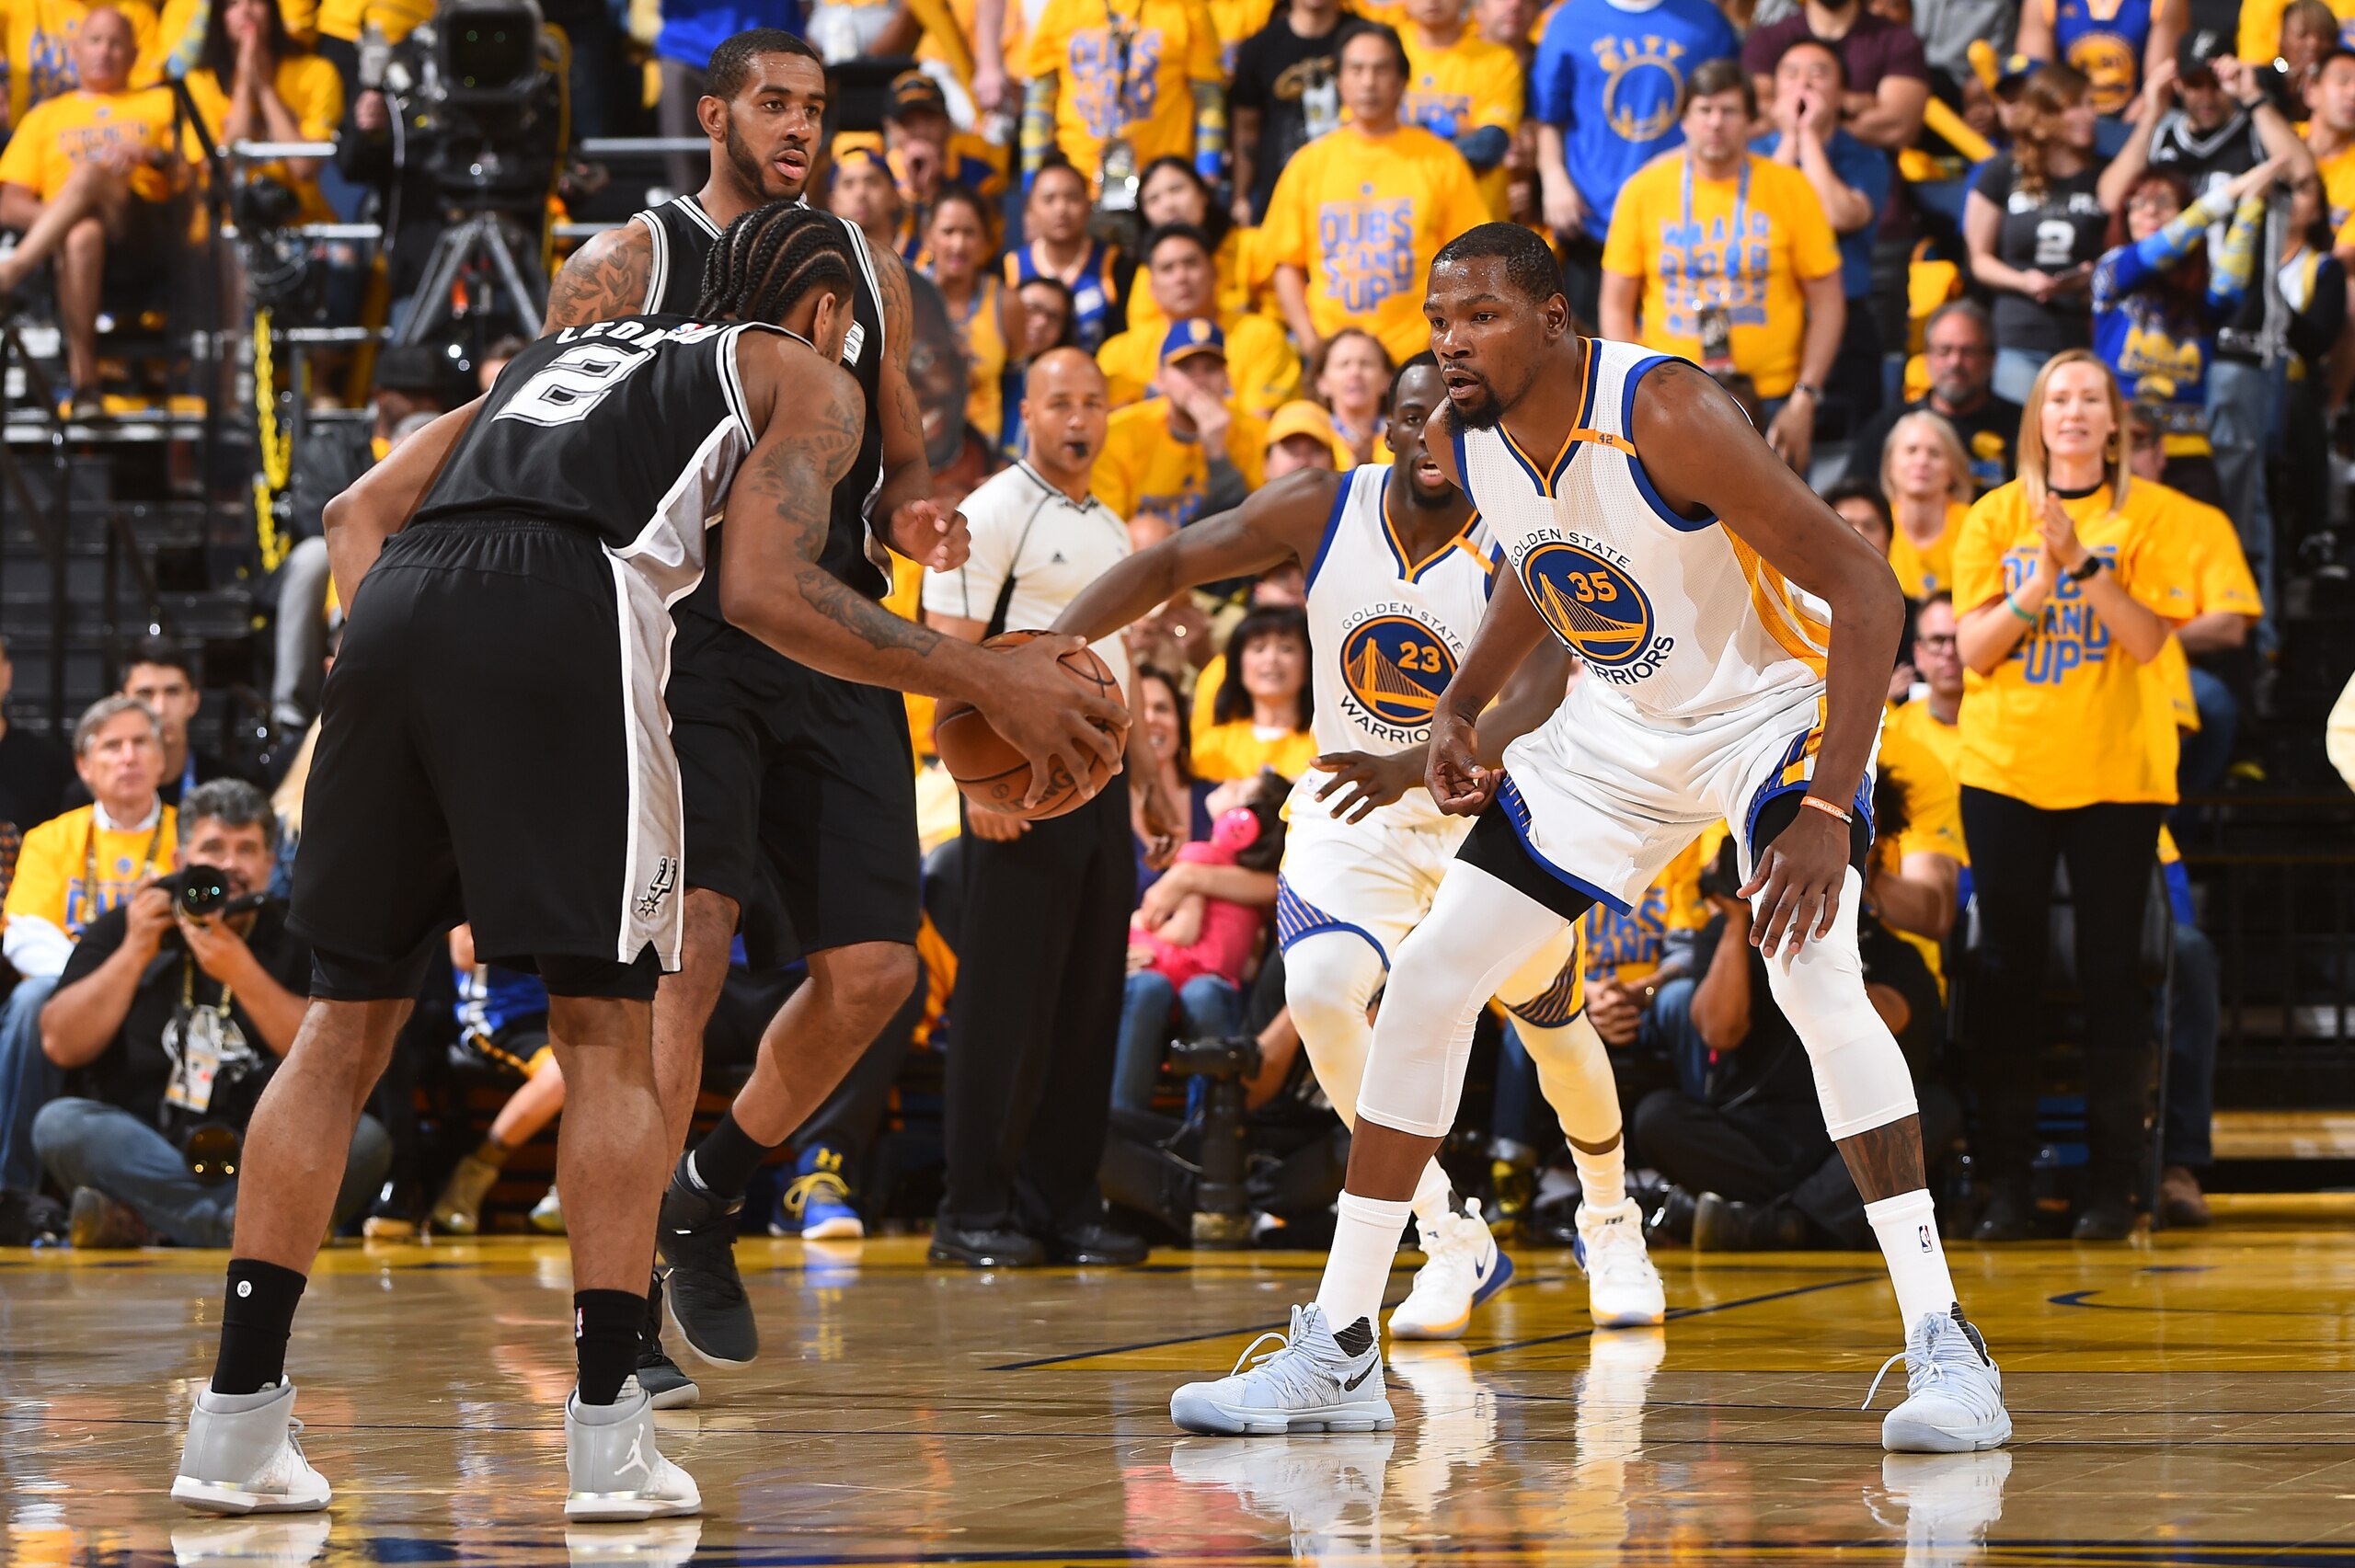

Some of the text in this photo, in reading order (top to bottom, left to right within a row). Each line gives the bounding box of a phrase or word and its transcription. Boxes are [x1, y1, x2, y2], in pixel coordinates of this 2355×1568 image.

[2035, 219, 2075, 265] 2
[1343, 275, 1391, 311] UP
[491, 343, 657, 428] 2
[1599, 433, 1614, 444] 42
[1511, 528, 1631, 569] GOLDEN STATE
[1567, 570, 1617, 603] 35
[1342, 602, 1465, 653] GOLDEN STATE
[1397, 641, 1442, 673] 23
[2025, 640, 2080, 684] UP
[1340, 695, 1431, 744] WARRIO
